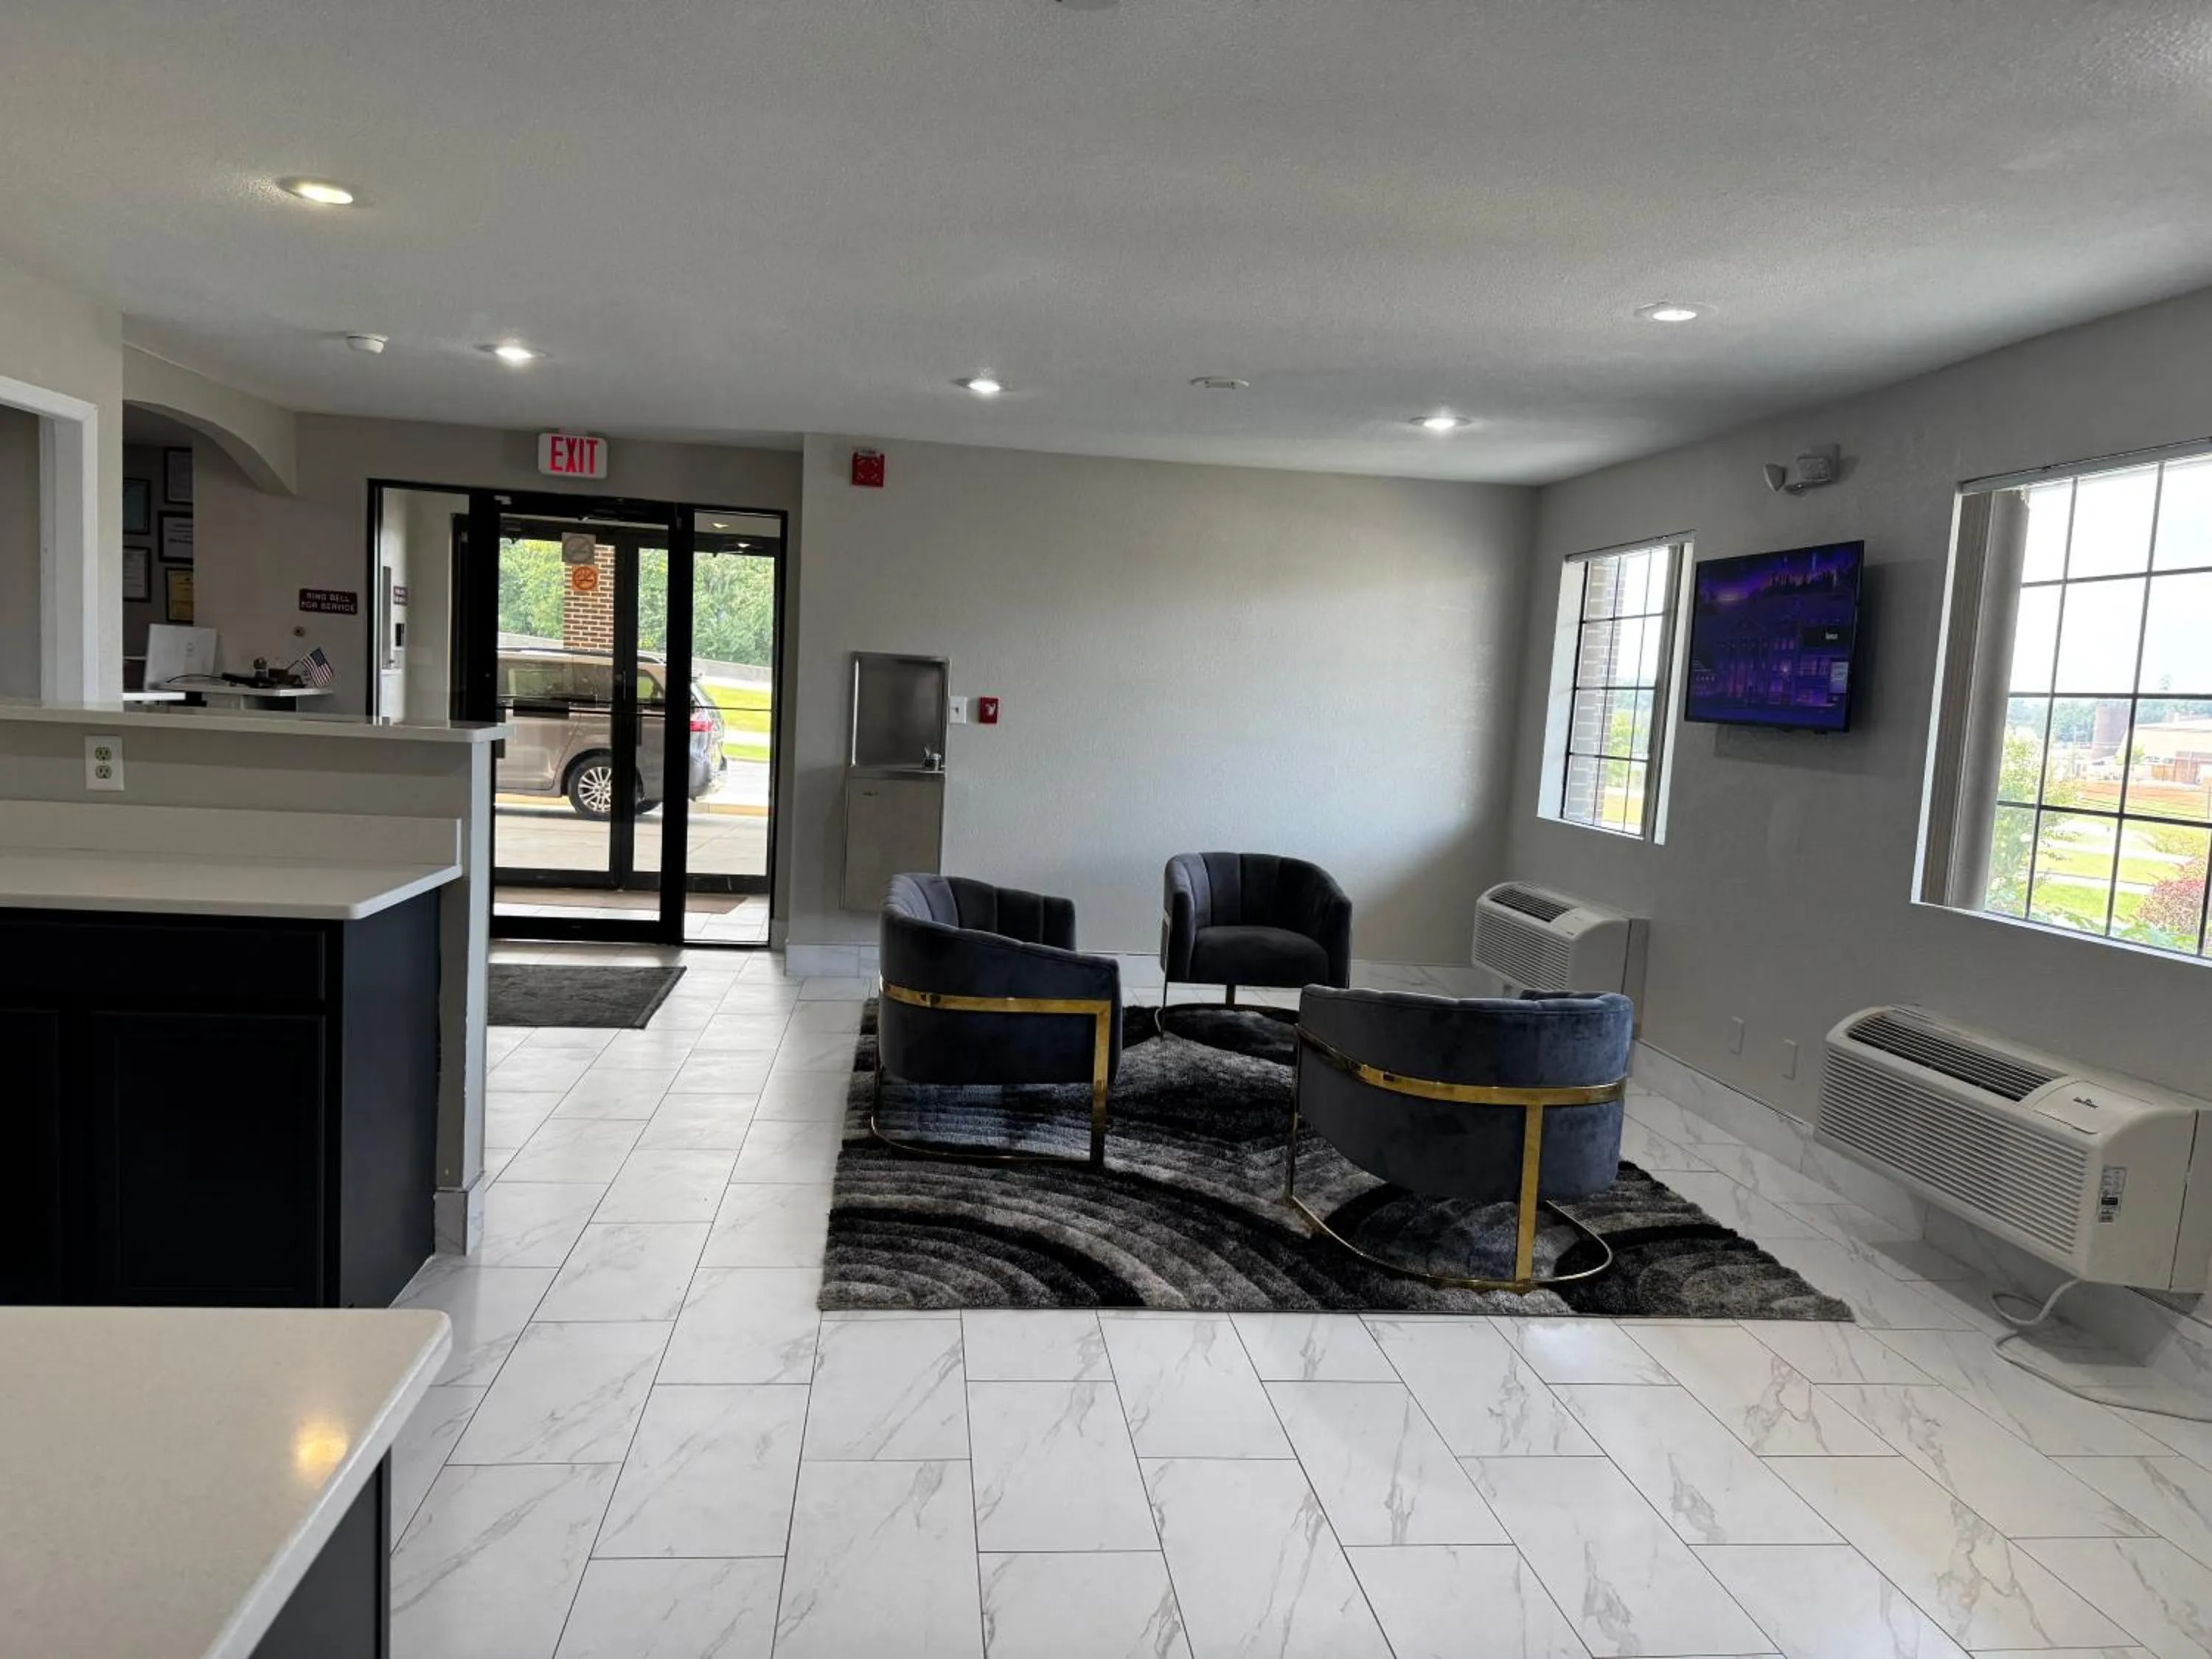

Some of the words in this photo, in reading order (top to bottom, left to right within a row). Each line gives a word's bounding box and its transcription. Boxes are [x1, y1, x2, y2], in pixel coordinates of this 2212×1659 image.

[551, 436, 598, 474] EXIT
[306, 592, 327, 601] RING
[330, 594, 350, 602] BELL
[321, 602, 355, 613] SERVICE
